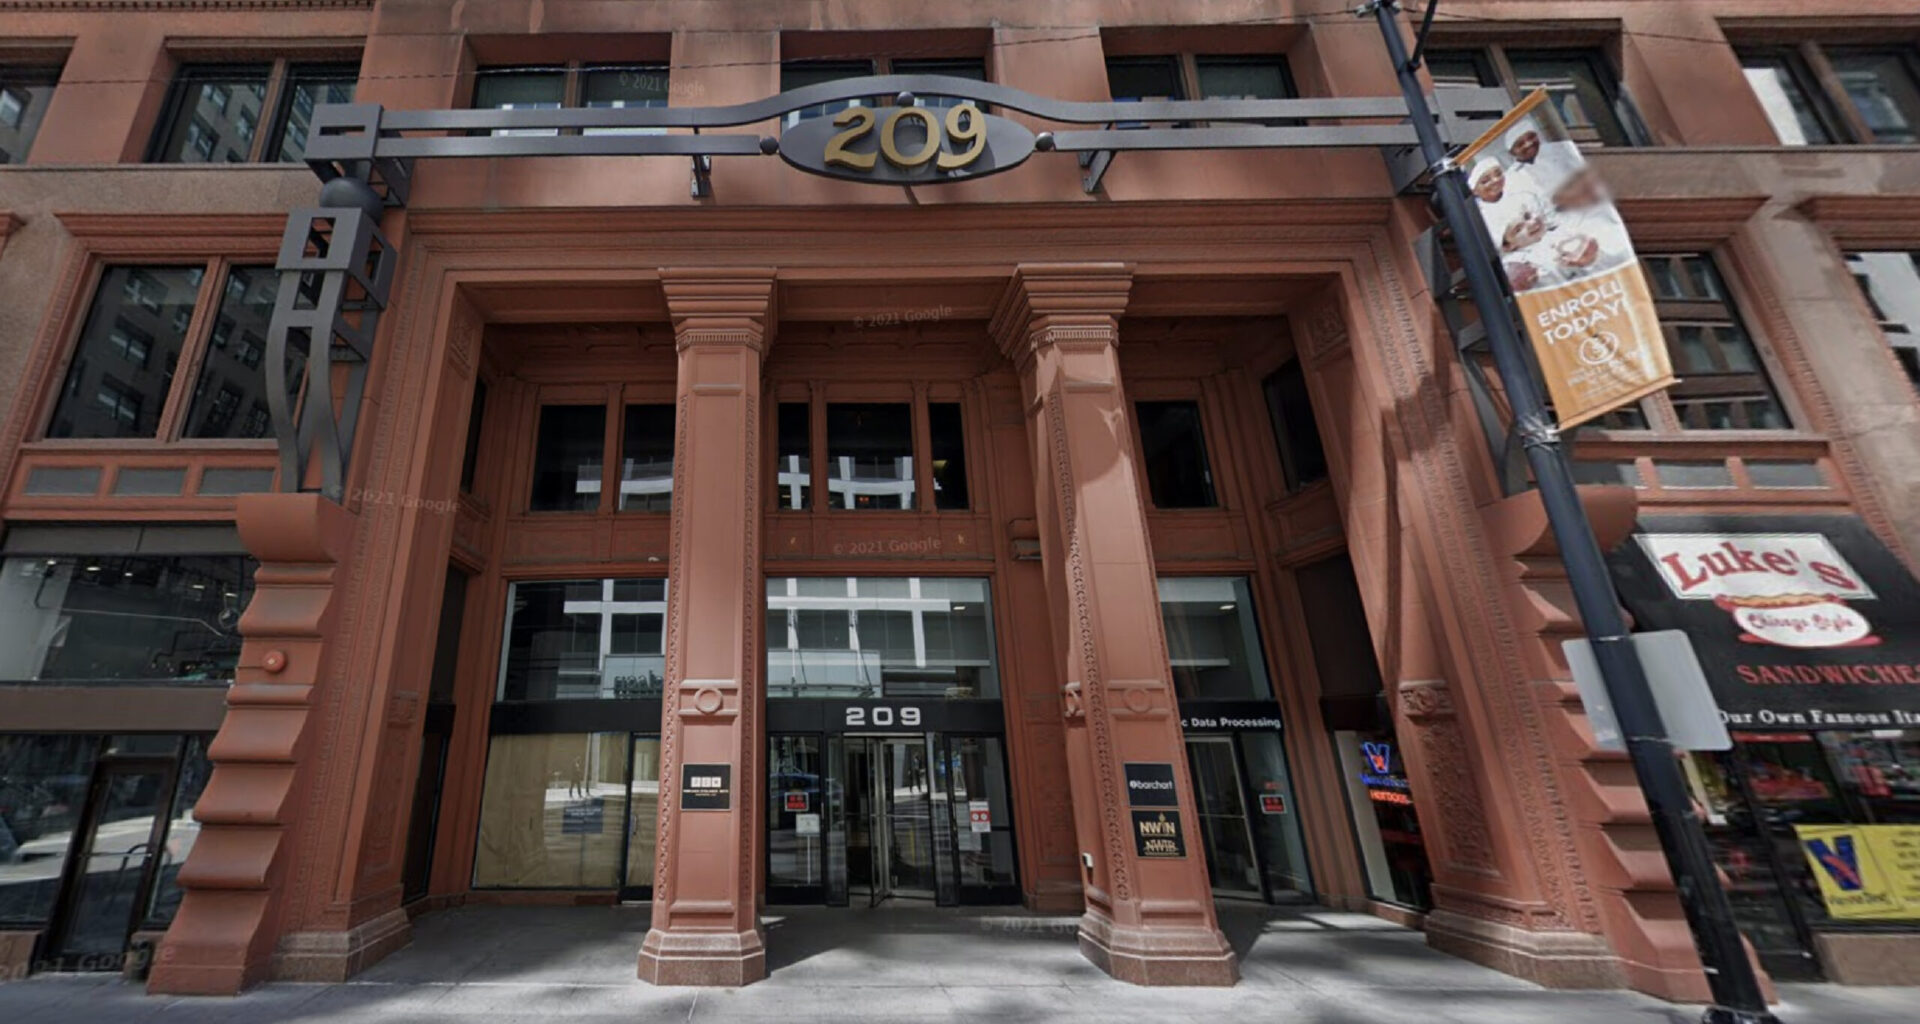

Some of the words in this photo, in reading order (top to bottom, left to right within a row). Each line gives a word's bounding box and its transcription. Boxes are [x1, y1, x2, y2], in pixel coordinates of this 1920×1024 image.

[824, 103, 987, 171] 209
[1537, 280, 1623, 327] ENROLL
[1661, 541, 1859, 591] Luke's
[1747, 612, 1809, 632] Chicago
[846, 707, 921, 726] 209
[1191, 717, 1217, 728] Data
[1220, 716, 1281, 730] Processing
[1759, 709, 1806, 724] Own
[1809, 709, 1890, 724] Famous
[1139, 780, 1173, 790] barchart
